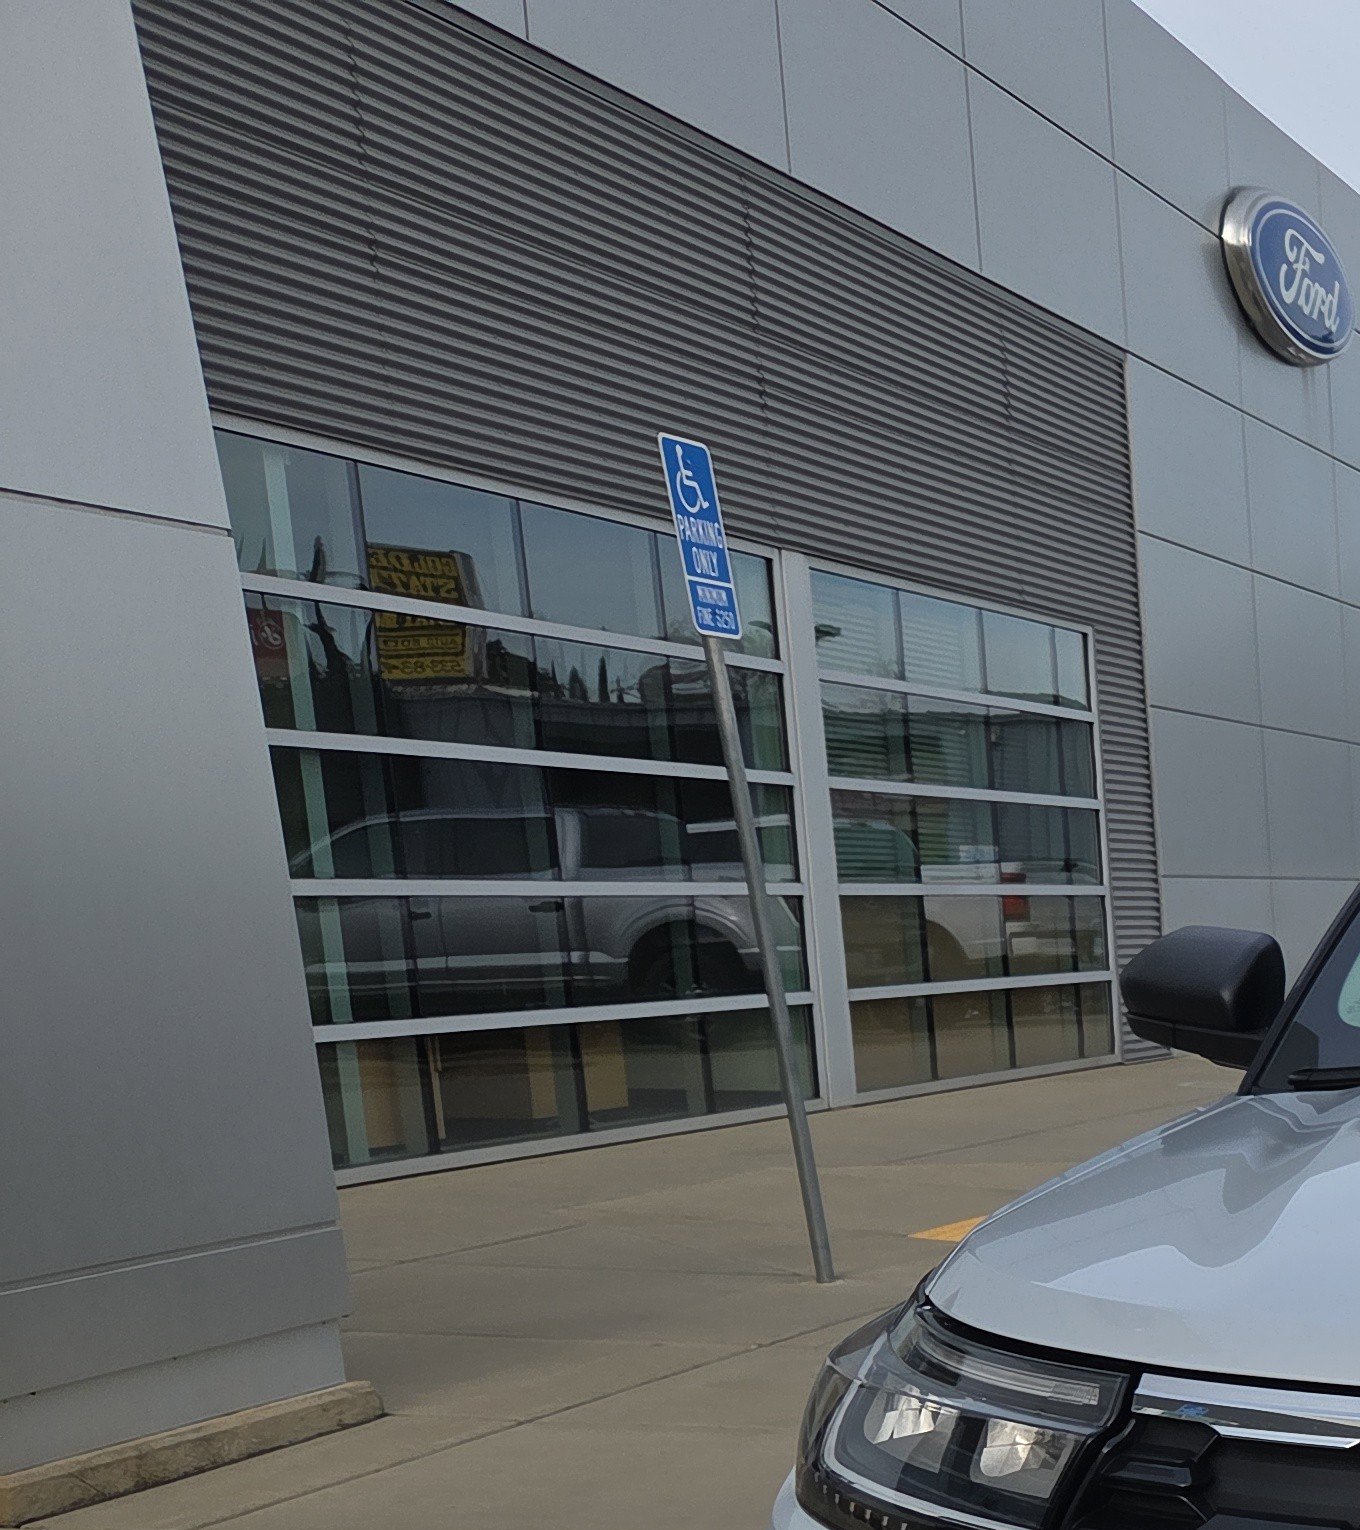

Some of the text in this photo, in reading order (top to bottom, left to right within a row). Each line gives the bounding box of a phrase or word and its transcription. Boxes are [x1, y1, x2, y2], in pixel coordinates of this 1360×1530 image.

[1279, 228, 1340, 334] Ford
[678, 514, 723, 549] PARKING
[691, 546, 719, 577] ONLY
